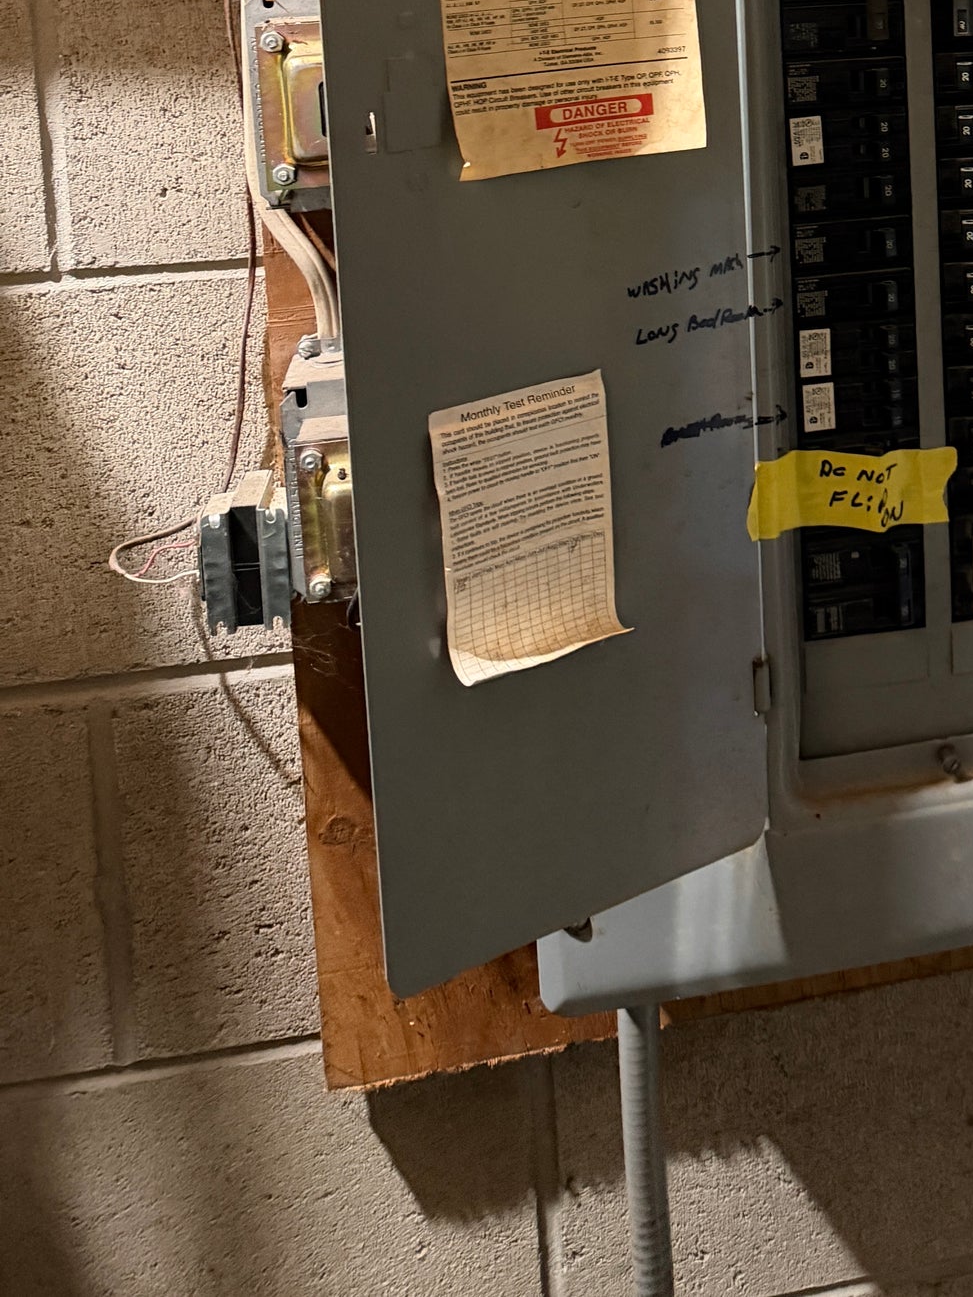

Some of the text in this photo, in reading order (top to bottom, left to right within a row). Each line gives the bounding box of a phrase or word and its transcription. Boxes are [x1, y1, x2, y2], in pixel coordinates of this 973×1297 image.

[527, 83, 555, 92] designed
[577, 79, 590, 87] only
[620, 74, 635, 82] Type
[642, 78, 674, 87] equipment
[961, 72, 970, 82] 20
[451, 82, 487, 92] WARNING
[880, 78, 888, 89] 20
[561, 100, 628, 121] DANGER
[564, 117, 651, 134] HAZARD OF ELECTRICAL
[880, 121, 889, 133] 20
[963, 125, 971, 135] 20
[578, 126, 638, 139] SHOCK OR BURN
[881, 148, 890, 159] 20
[964, 178, 973, 189] 20
[884, 185, 893, 197] 20
[965, 231, 973, 241] 20
[460, 385, 576, 422] Monthly Test Reminder
[453, 428, 466, 436] card
[466, 423, 484, 432] should
[492, 416, 510, 426] placed
[819, 459, 898, 485] DO NOT
